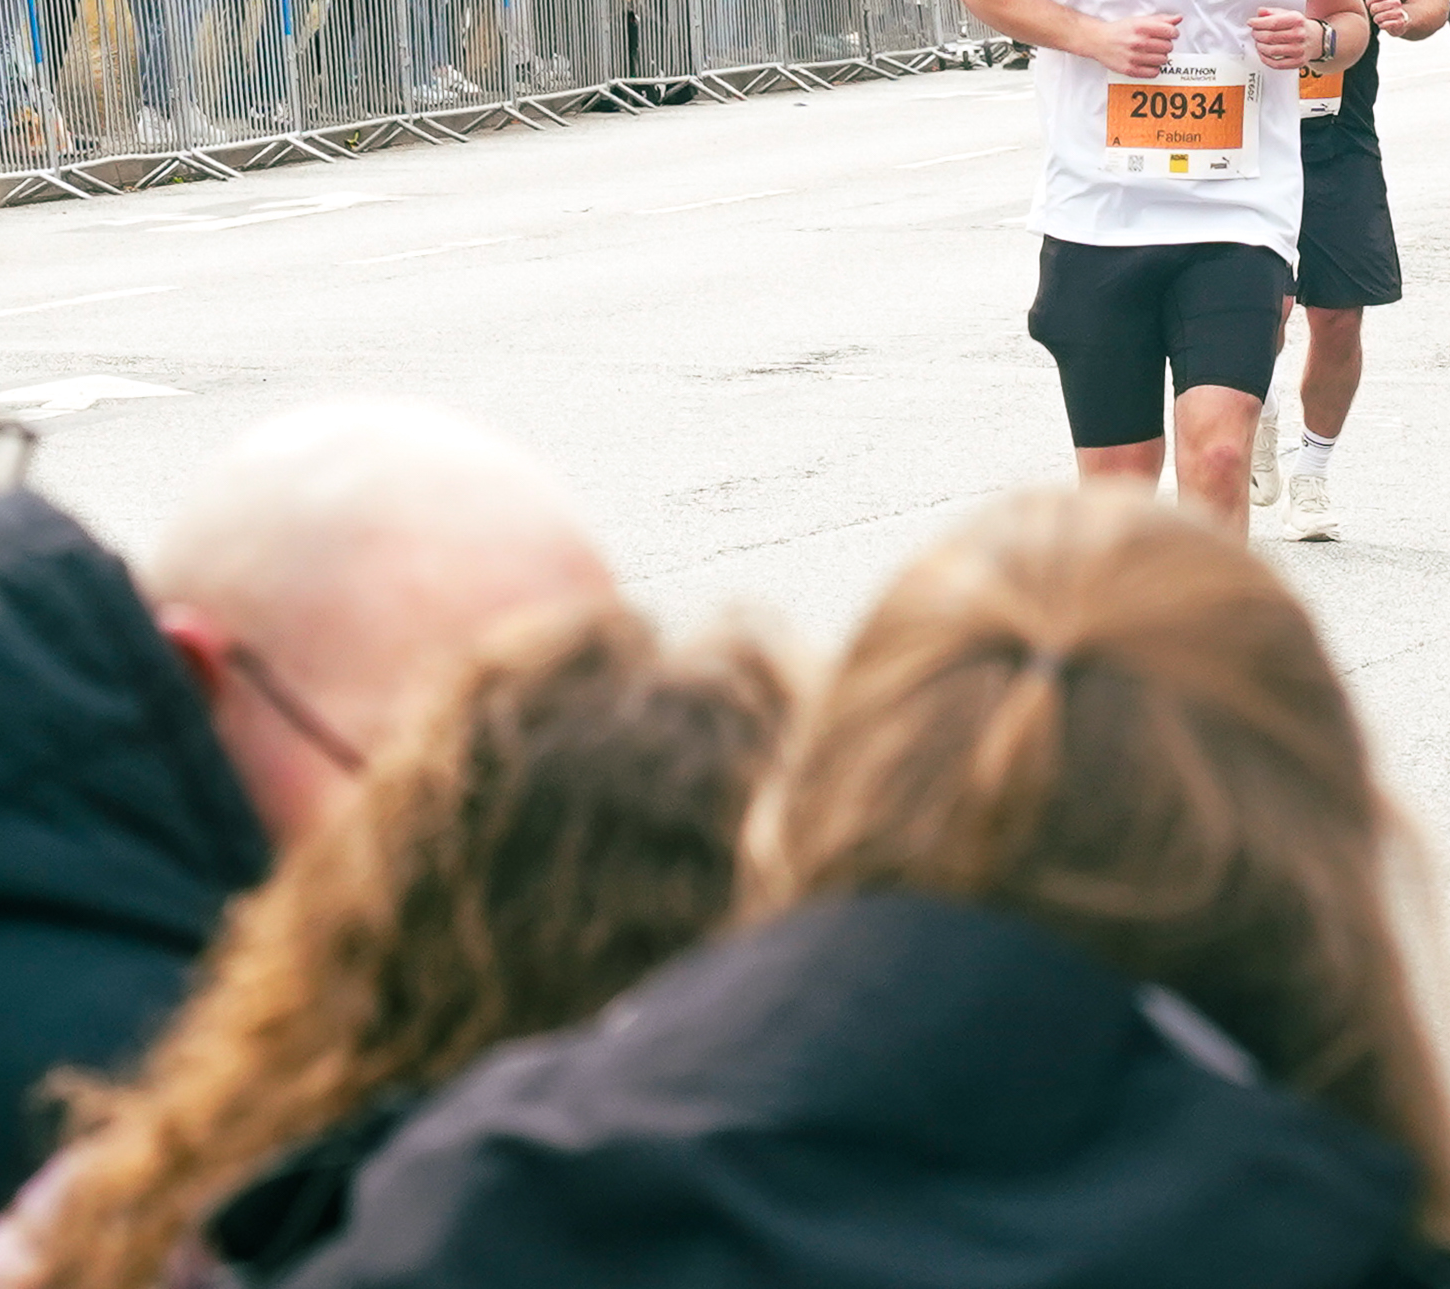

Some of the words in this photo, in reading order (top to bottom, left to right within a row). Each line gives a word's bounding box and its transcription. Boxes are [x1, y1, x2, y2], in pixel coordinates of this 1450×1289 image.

[1159, 67, 1217, 75] MARATHON
[1130, 90, 1226, 120] 20934
[1112, 136, 1121, 146] A
[1156, 129, 1202, 143] Fabian
